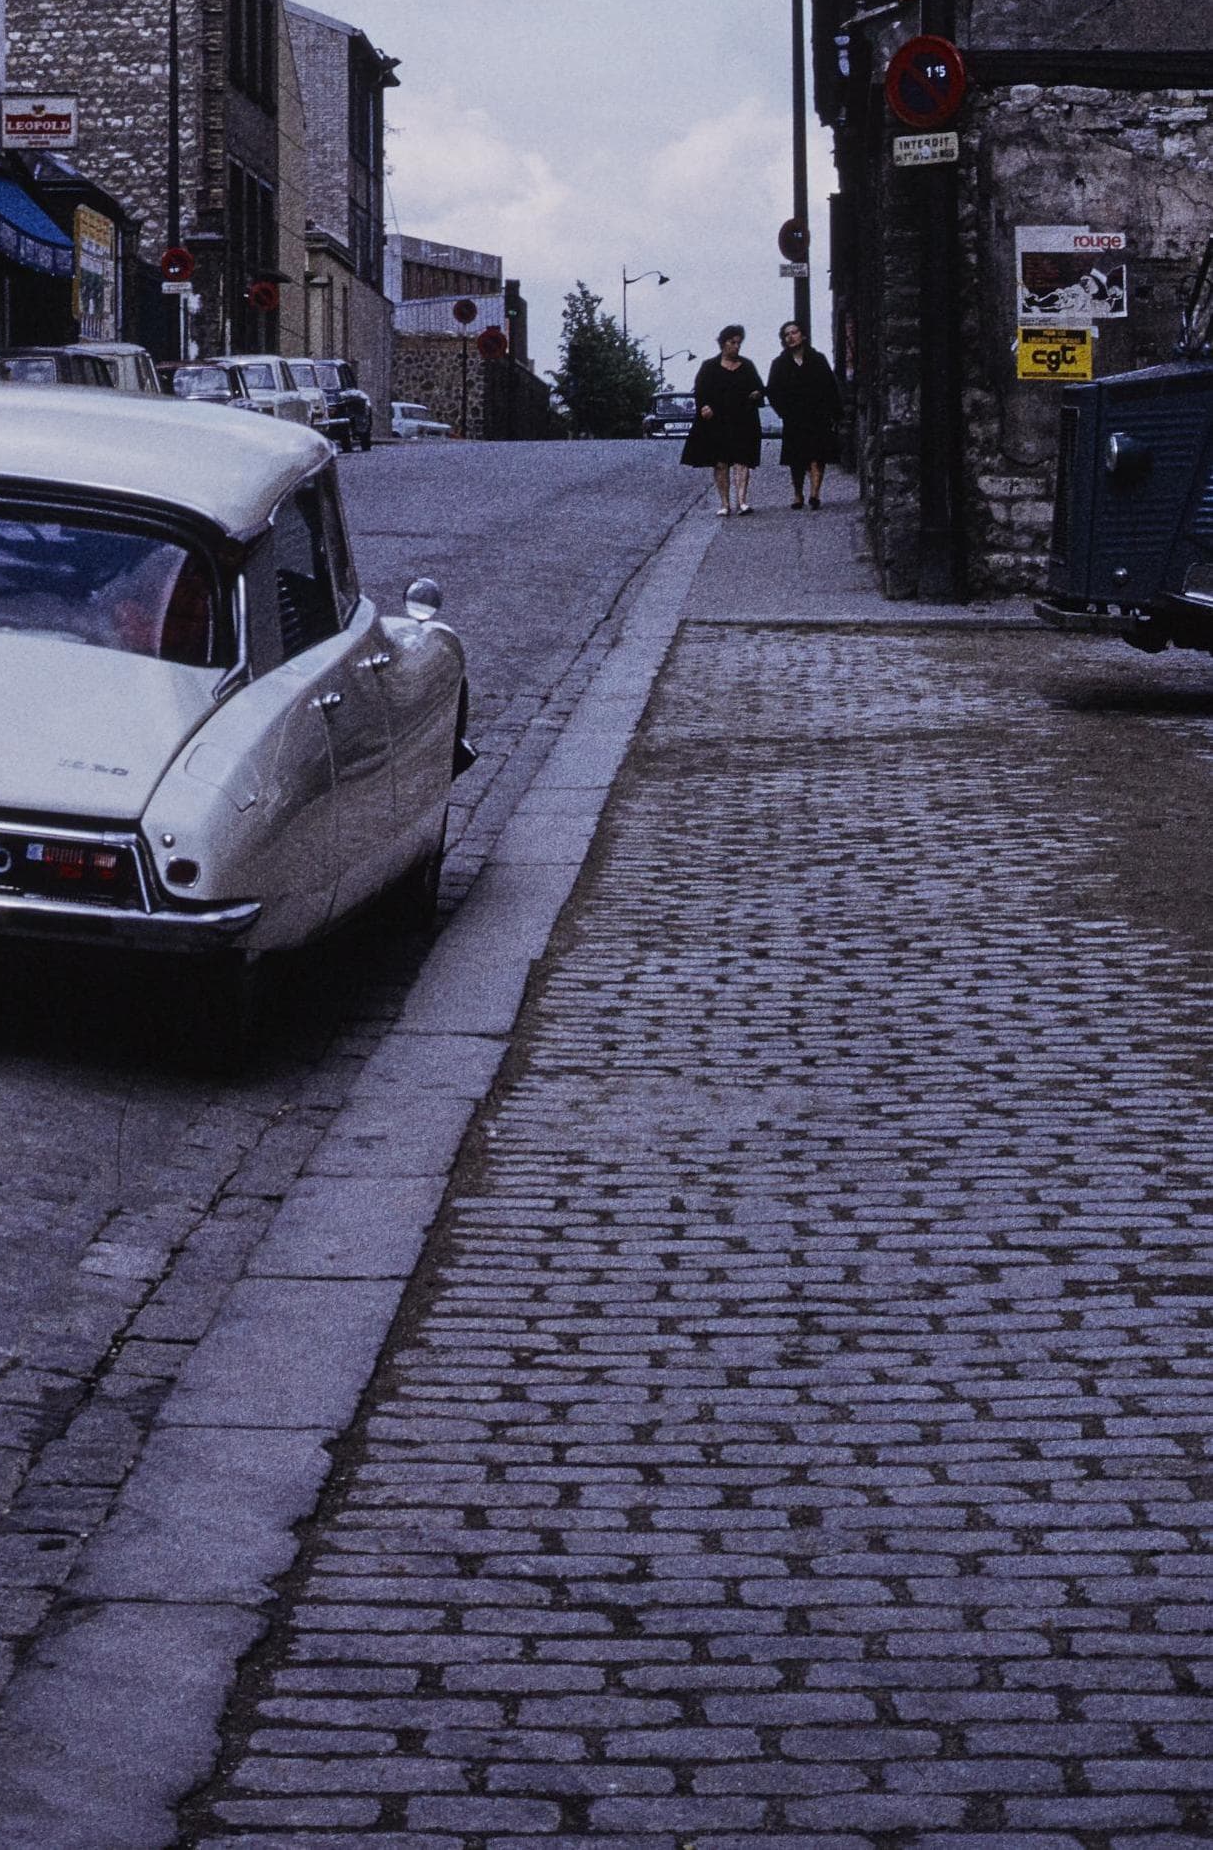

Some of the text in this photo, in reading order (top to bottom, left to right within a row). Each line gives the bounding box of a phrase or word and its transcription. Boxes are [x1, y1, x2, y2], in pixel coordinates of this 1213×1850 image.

[7, 120, 70, 131] LEOPOLD
[899, 137, 950, 150] INTERDIT
[1073, 235, 1121, 249] rouge
[1031, 344, 1077, 372] cgt
